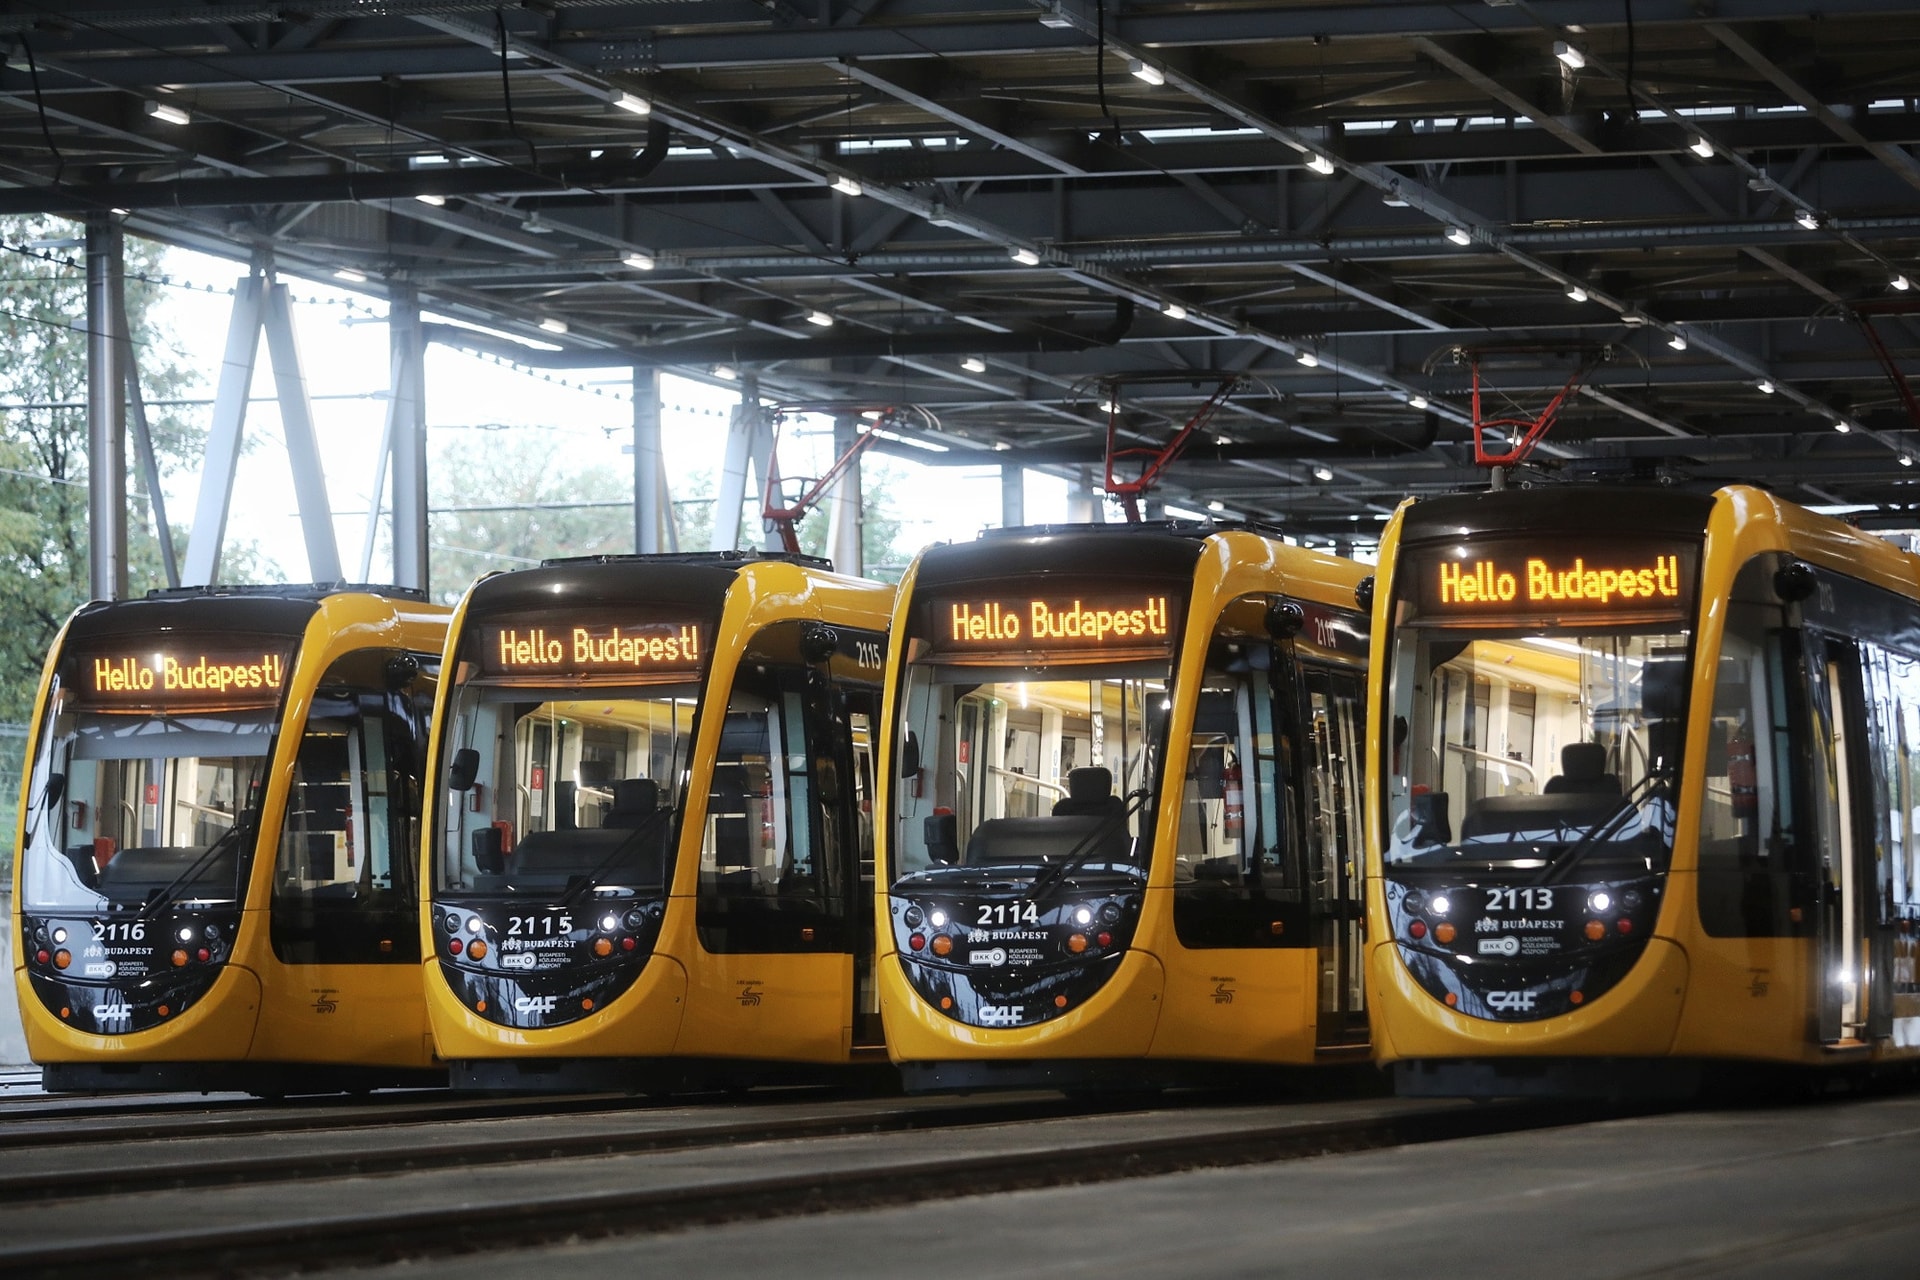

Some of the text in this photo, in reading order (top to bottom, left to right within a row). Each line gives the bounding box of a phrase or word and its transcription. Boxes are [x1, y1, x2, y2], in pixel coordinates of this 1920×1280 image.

[1440, 555, 1678, 603] Hello Budapest!
[952, 597, 1166, 640] Hello Budapest!
[1314, 617, 1336, 648] 2114
[500, 625, 698, 665] Hello Budapest!
[855, 641, 881, 670] 2115
[95, 654, 281, 692] Hello Budapest!
[1485, 888, 1553, 911] 2113
[976, 904, 1039, 925] 2114
[1501, 920, 1565, 929] BUDAPEST
[91, 923, 146, 941] 2116
[507, 916, 573, 935] 2115
[992, 931, 1049, 940] BUDAPEST
[104, 947, 154, 956] BUDAPEST
[524, 940, 577, 949] BUDAPEST
[514, 995, 558, 1014] CAF
[1486, 991, 1538, 1012] CAF
[93, 1003, 133, 1022] CAF
[978, 1005, 1025, 1025] CAF
